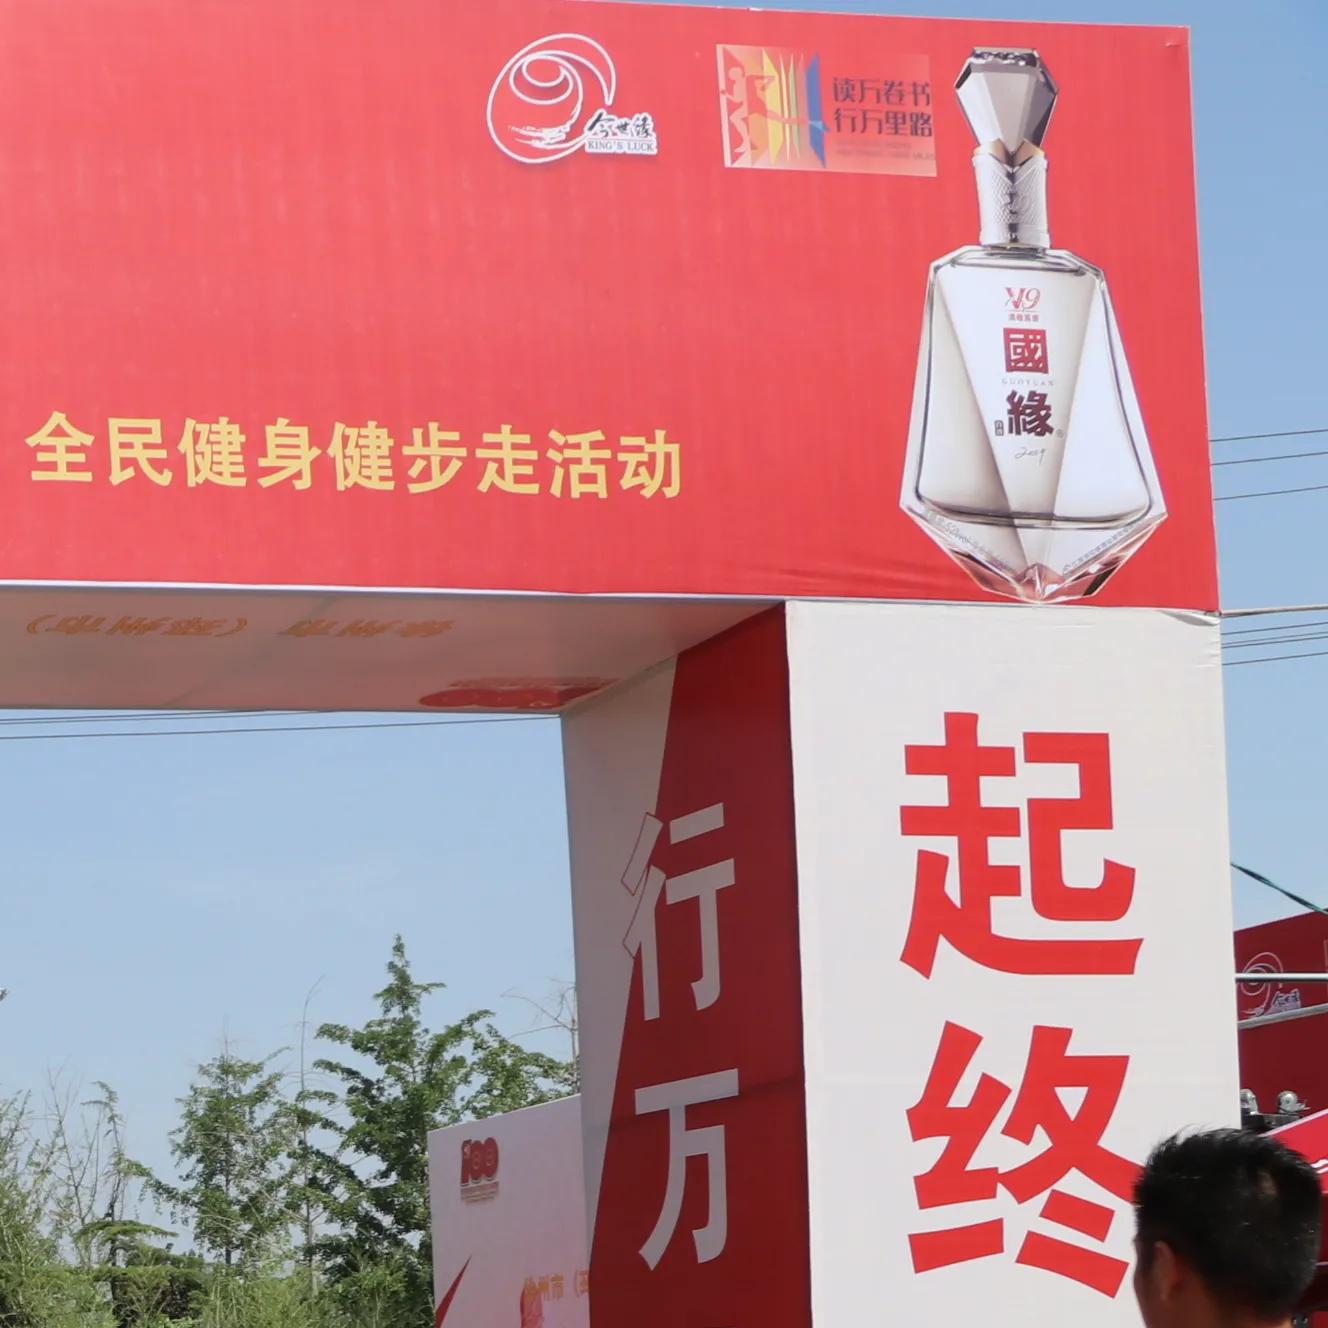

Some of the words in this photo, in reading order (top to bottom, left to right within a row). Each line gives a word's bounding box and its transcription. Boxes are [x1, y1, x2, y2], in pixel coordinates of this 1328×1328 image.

[833, 77, 931, 106] 读万卷书
[834, 108, 933, 137] 行万里路
